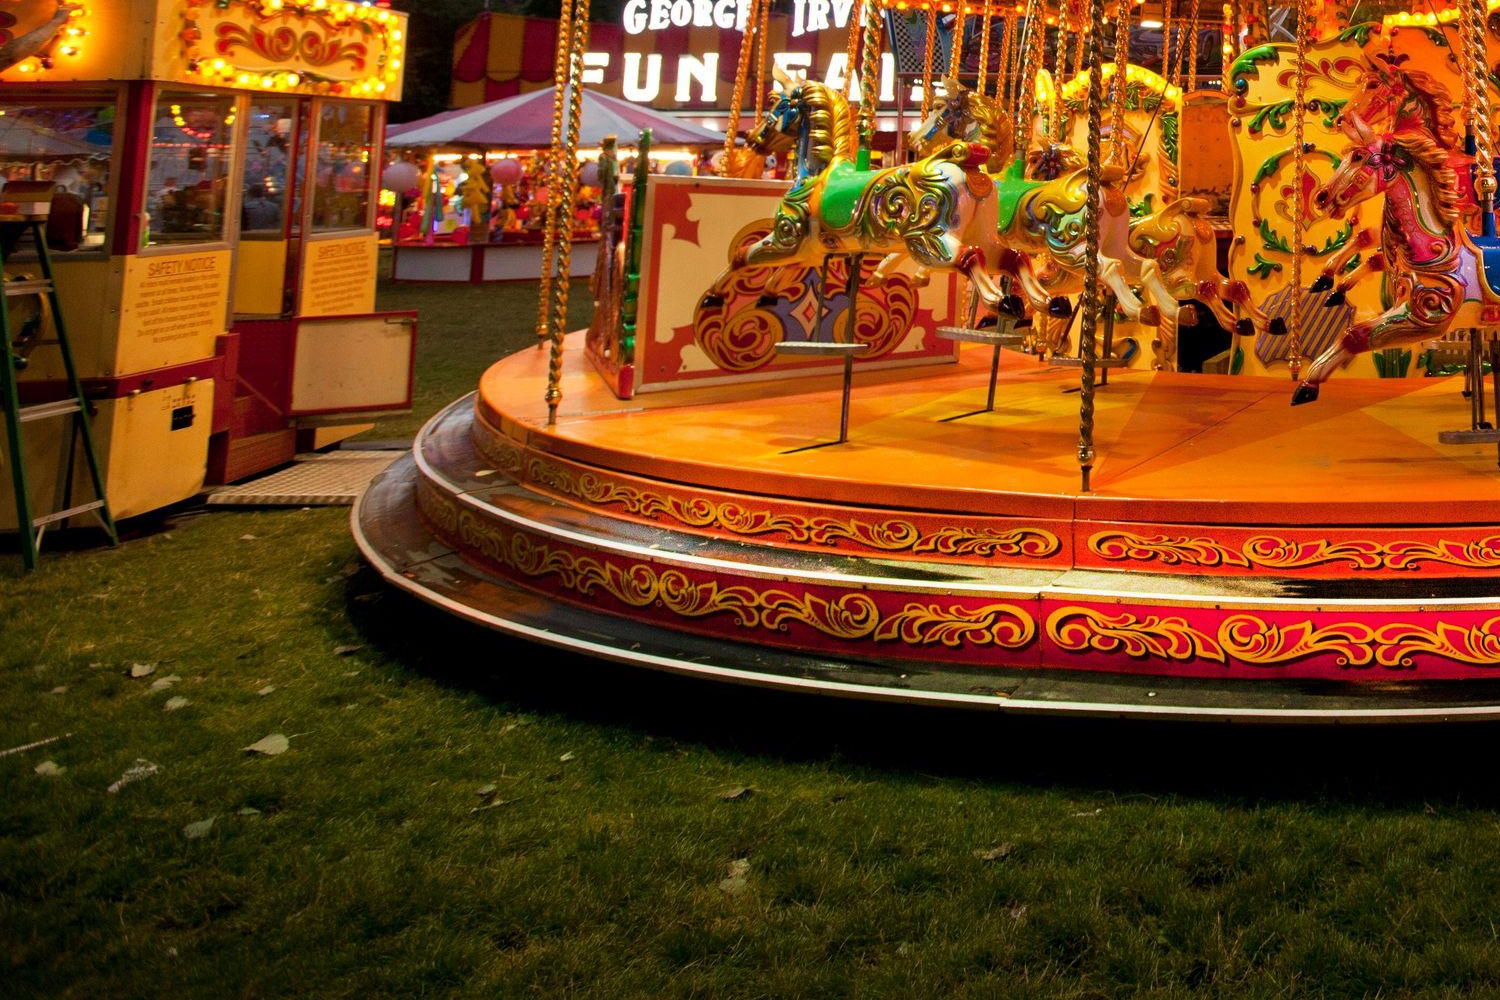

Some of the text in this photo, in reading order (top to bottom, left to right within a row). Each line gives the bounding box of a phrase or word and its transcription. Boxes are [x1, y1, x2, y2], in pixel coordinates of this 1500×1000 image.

[569, 52, 947, 102] FUN FAI
[148, 256, 217, 276] SAFETY NOTICE
